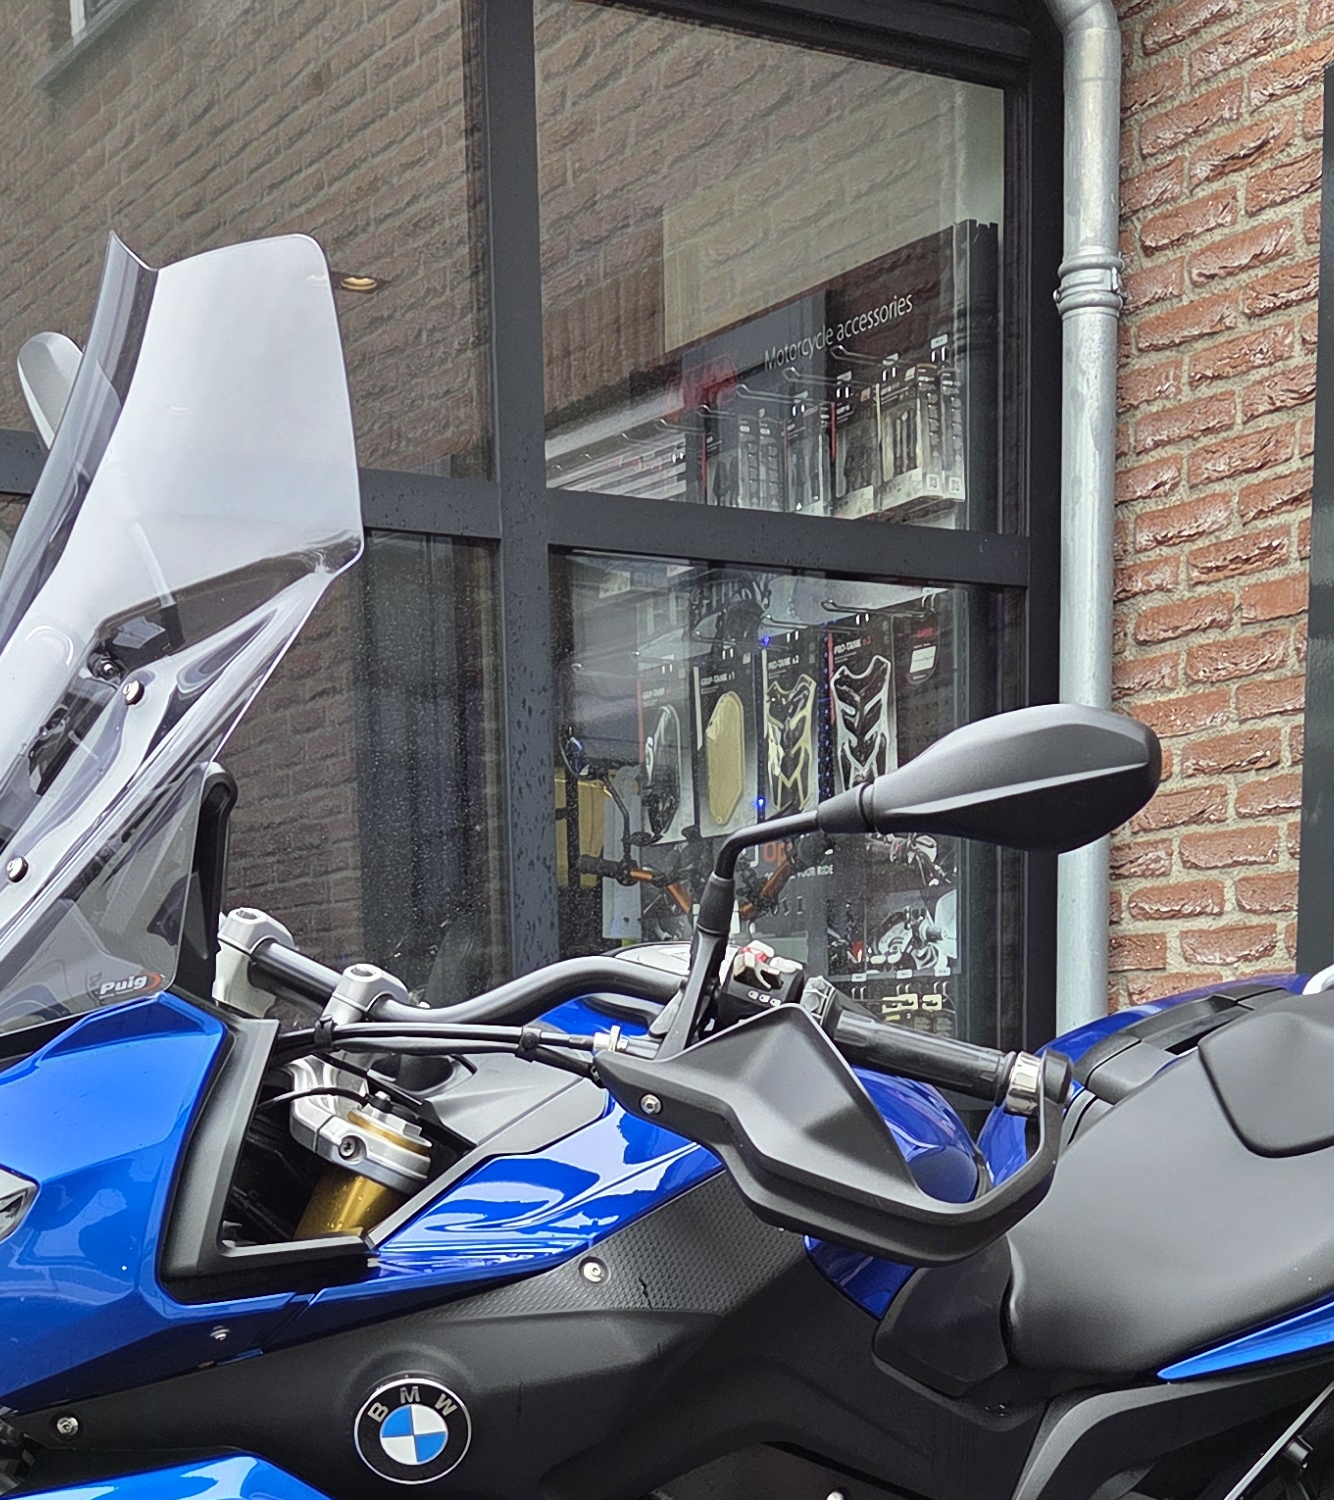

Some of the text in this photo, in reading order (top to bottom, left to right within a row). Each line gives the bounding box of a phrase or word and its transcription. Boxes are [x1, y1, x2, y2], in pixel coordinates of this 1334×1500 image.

[765, 294, 914, 371] Motorcycle accessories
[99, 975, 147, 995] Puig
[367, 1386, 458, 1423] BMW
